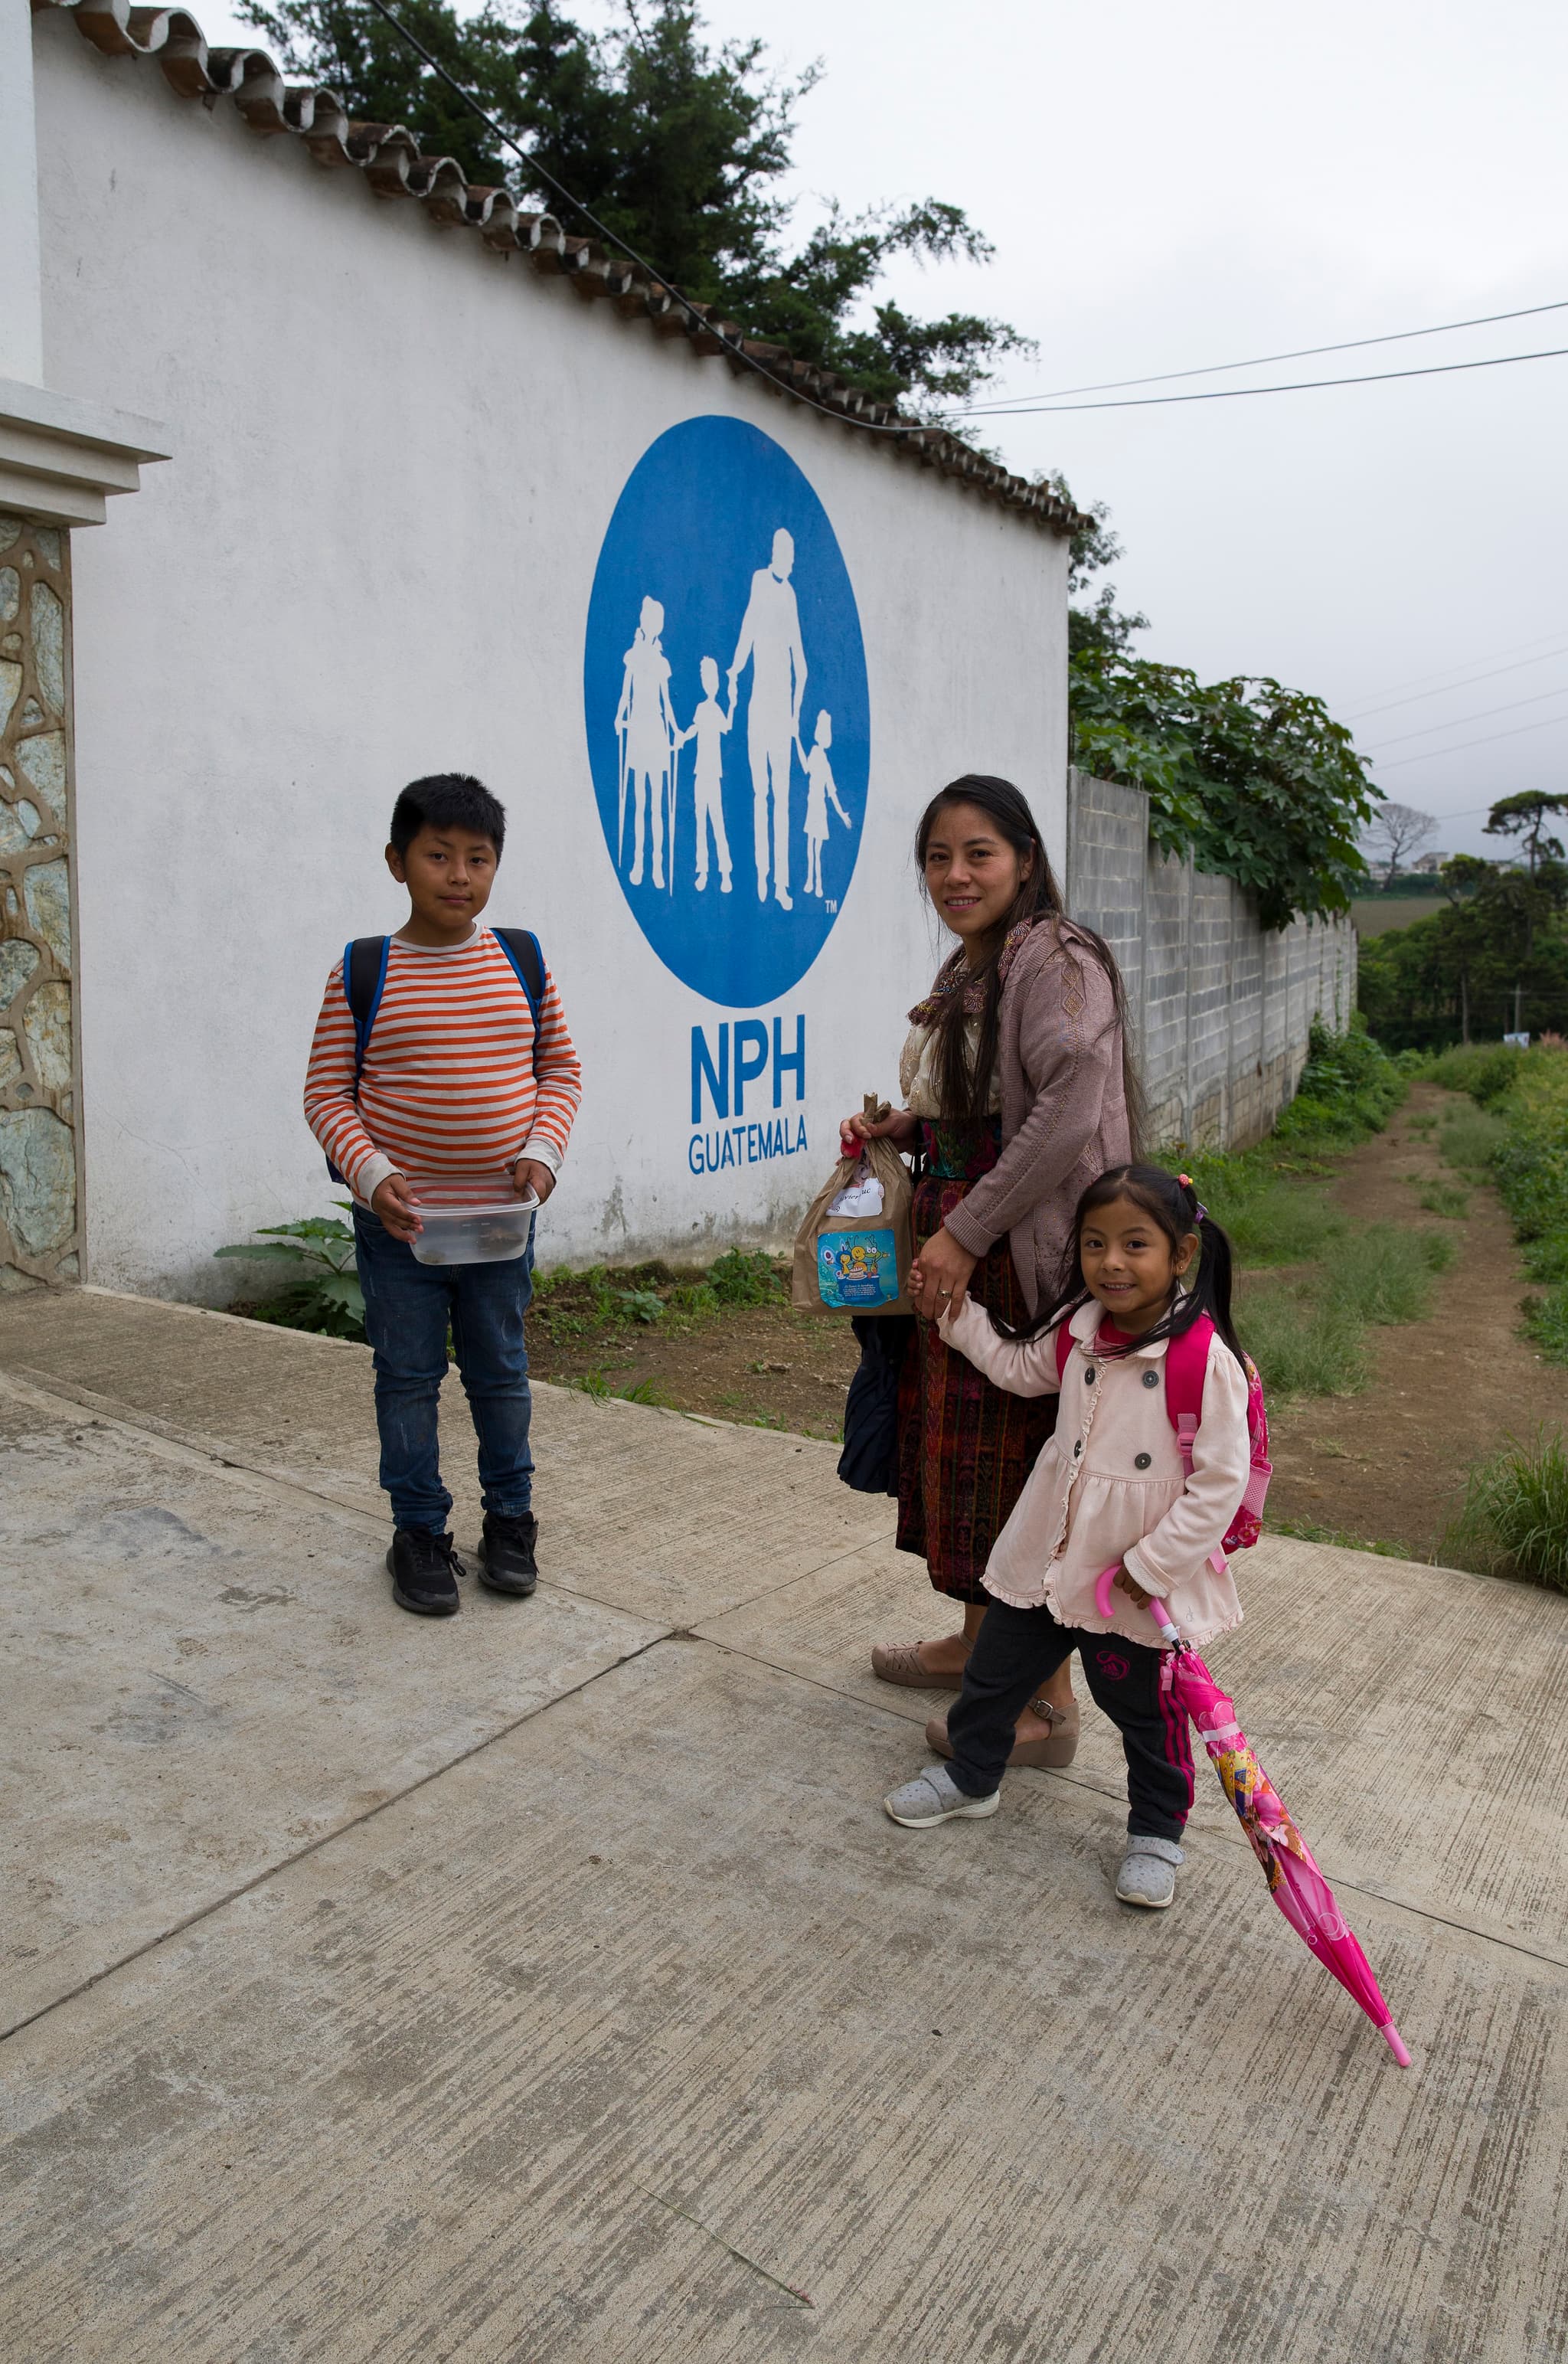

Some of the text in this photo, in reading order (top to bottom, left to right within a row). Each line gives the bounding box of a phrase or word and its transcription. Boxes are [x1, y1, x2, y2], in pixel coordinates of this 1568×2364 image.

[825, 900, 838, 914] TM
[691, 1014, 805, 1124] NPH
[688, 1114, 808, 1175] GUATEMALA
